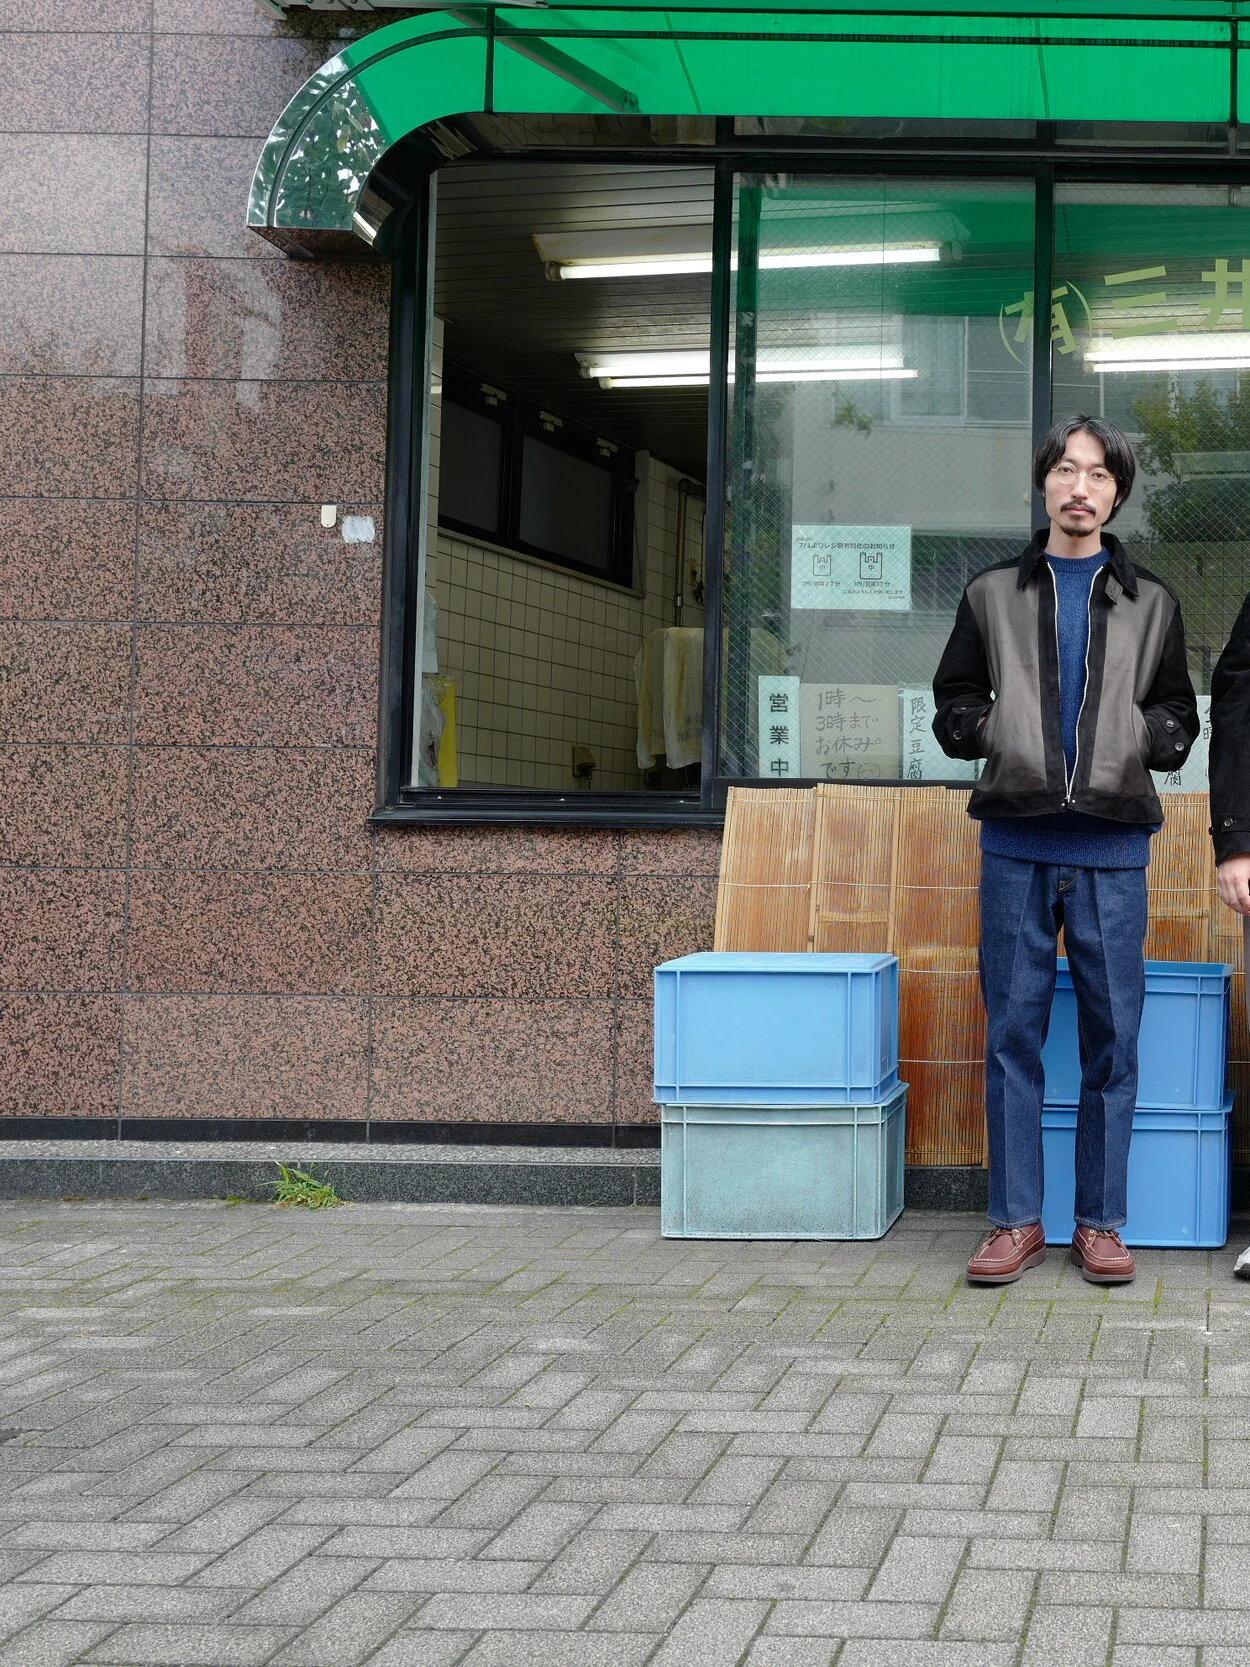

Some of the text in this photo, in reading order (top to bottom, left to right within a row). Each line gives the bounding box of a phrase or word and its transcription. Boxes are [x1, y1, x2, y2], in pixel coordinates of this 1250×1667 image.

[868, 563, 875, 571] 中
[815, 711, 879, 732] 3時まで
[769, 692, 790, 777] 営業中
[820, 757, 857, 779] です
